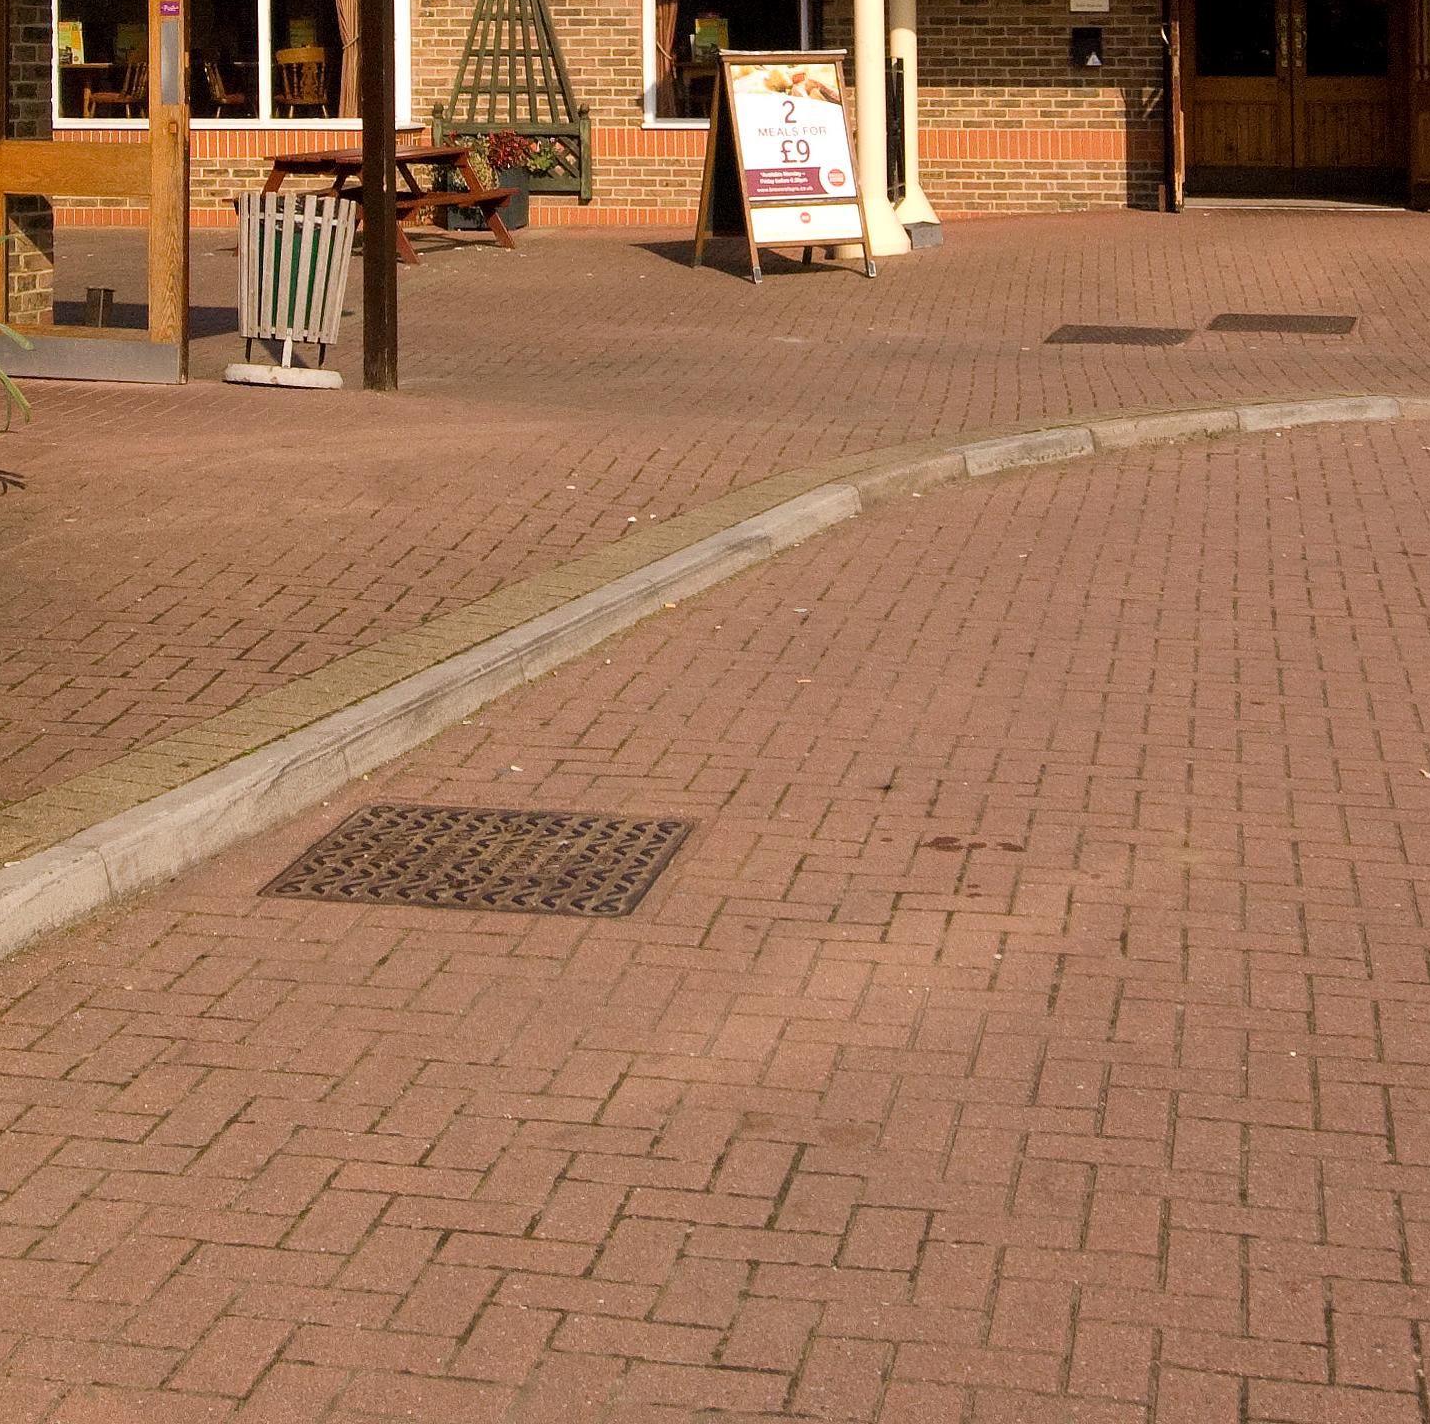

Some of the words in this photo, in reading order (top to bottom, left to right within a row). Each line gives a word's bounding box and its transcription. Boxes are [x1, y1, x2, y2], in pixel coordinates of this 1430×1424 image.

[782, 100, 797, 124] 2
[757, 127, 799, 137] MEALS
[802, 126, 827, 136] FOR
[780, 139, 811, 163] £9
